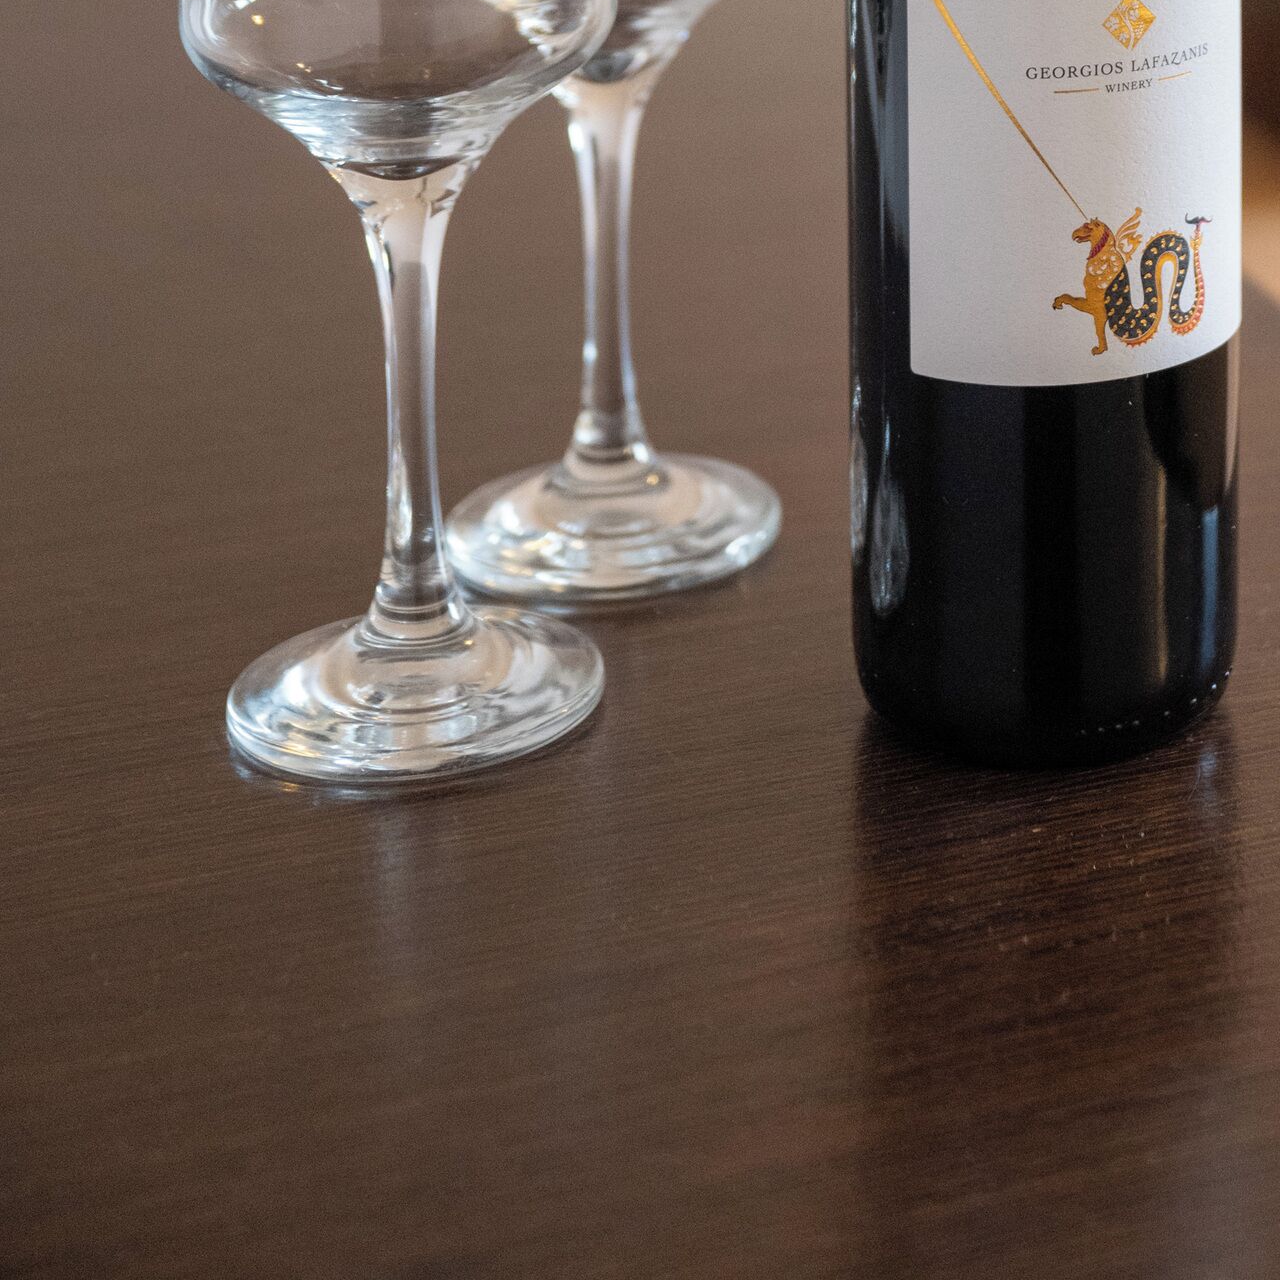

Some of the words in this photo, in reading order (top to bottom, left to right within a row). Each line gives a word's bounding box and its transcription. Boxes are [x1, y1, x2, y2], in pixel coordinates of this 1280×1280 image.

[1025, 61, 1124, 80] GEORGIOS
[1130, 42, 1210, 73] LAFAZANIS
[1105, 77, 1154, 94] WINERY
